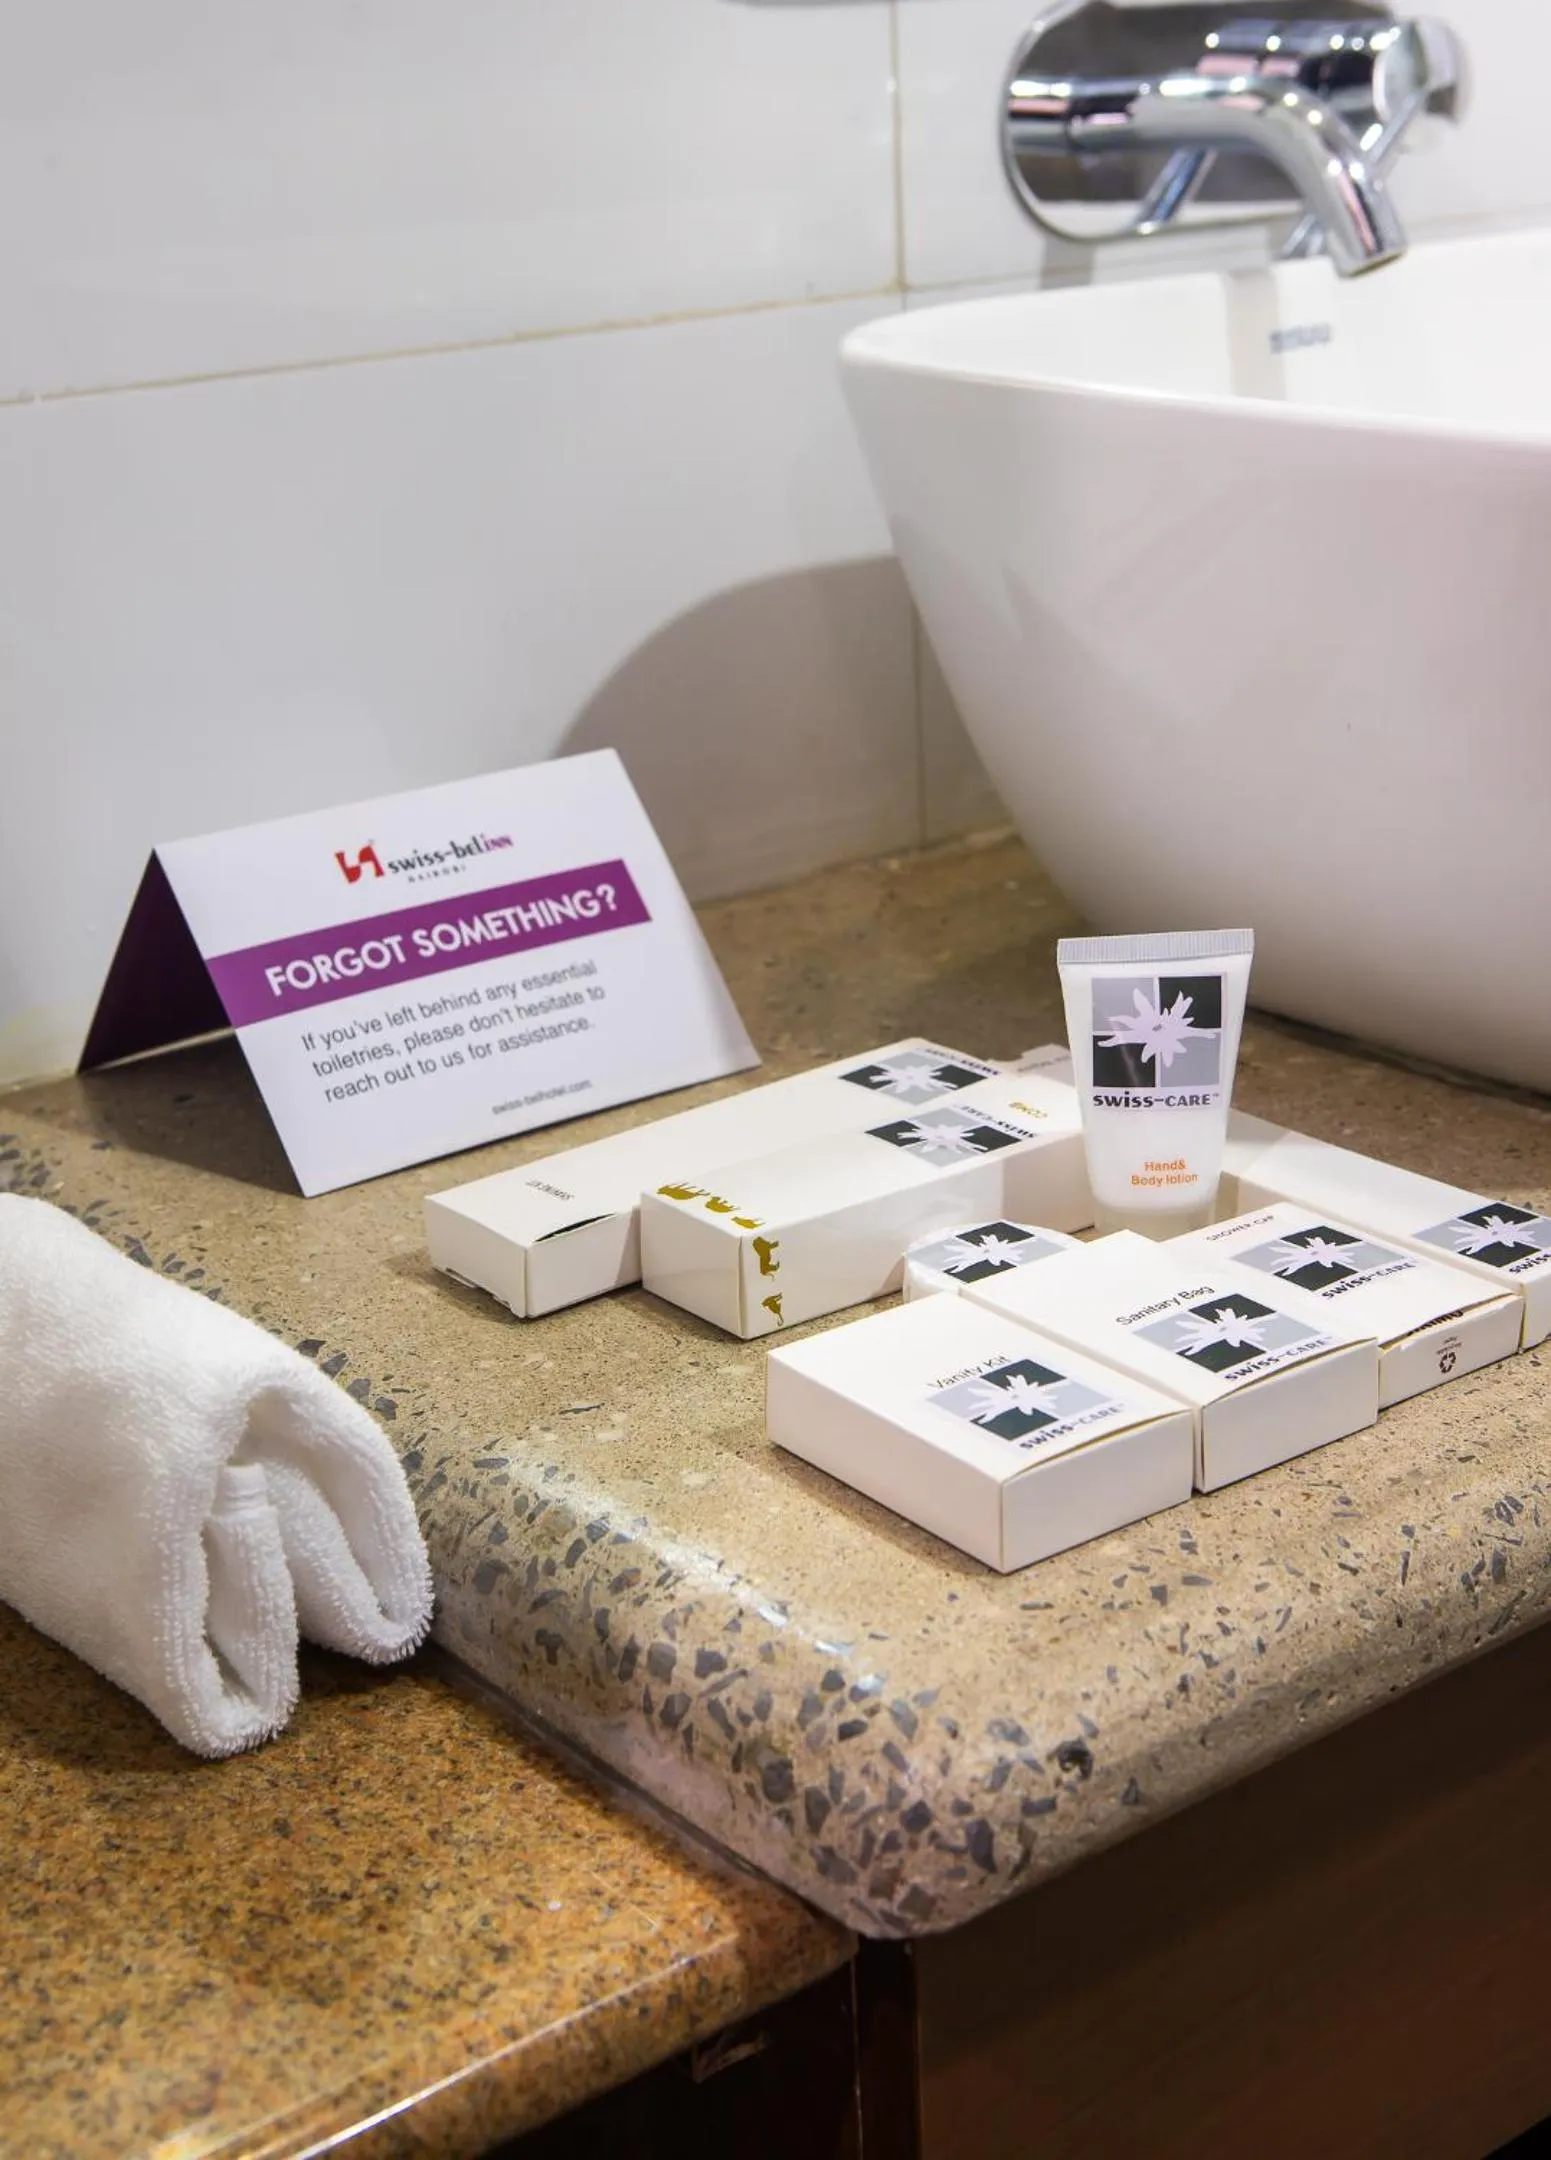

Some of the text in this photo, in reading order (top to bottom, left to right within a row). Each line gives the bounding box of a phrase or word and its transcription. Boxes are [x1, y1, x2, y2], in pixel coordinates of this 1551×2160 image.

[264, 883, 617, 996] FORGOT SOMETHING?
[301, 960, 598, 1052] If you've left behind any essential
[312, 986, 606, 1077] toiletries, please don't hesitate to
[324, 1017, 596, 1103] reach out to us for assistance.
[1131, 1173, 1198, 1187] Body lotion
[1144, 1158, 1187, 1172] Hand&
[1205, 1214, 1275, 1242] SHOWER CAP
[1115, 1285, 1215, 1325] Sanitary Bag
[926, 1354, 1011, 1390] Vanity Kit
